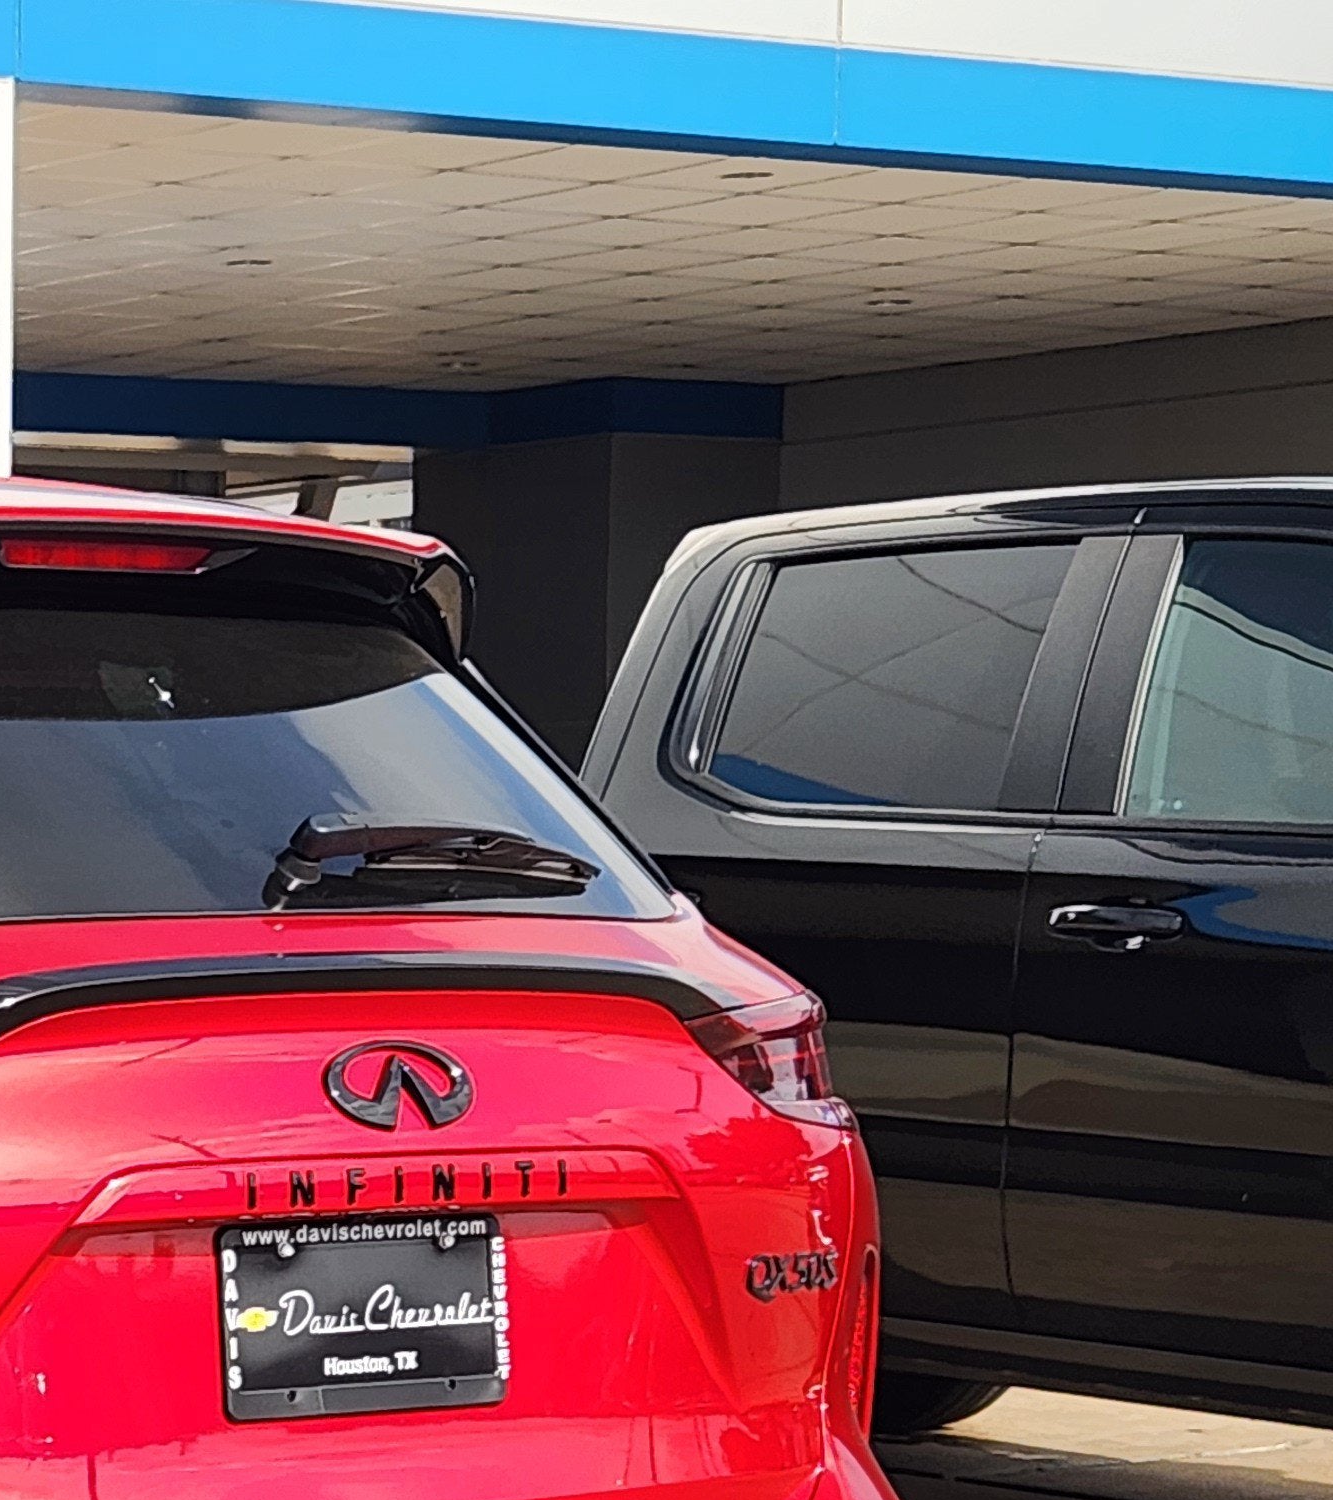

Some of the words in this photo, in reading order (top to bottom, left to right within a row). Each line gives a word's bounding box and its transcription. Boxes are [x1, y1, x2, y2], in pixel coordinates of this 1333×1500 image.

[246, 1159, 568, 1210] INFINITI
[242, 1219, 487, 1246] www.davischevrolet.com
[222, 1249, 243, 1390] DAVIS
[278, 1289, 365, 1336] Davis
[364, 1284, 495, 1330] Chevrolet
[491, 1236, 510, 1380] CHEVROLET
[323, 1356, 394, 1376] Houston,
[394, 1351, 419, 1371] TX
